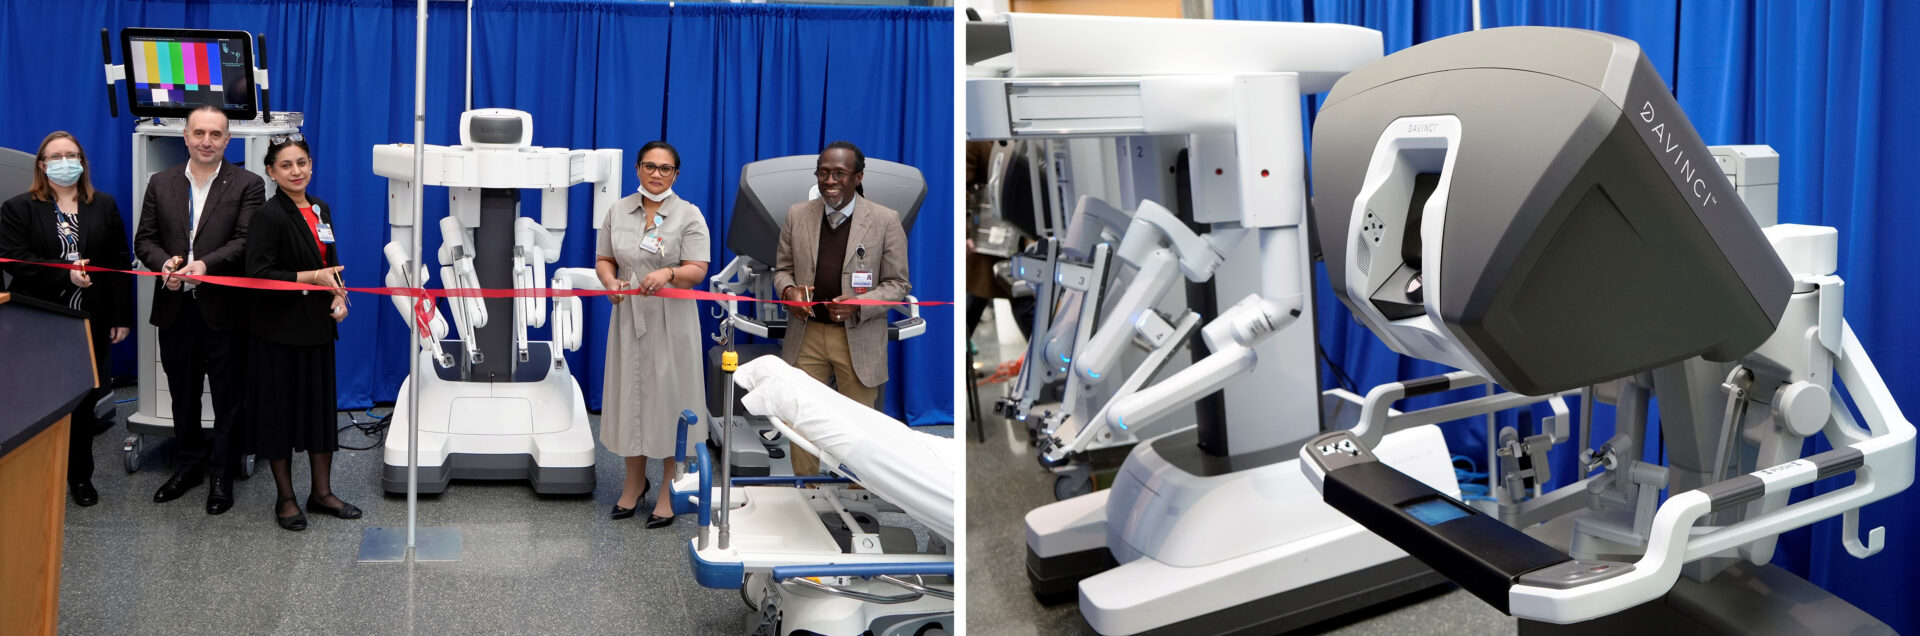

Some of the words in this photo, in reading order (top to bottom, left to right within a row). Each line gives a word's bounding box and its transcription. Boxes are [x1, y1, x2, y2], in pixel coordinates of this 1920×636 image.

[1136, 145, 1144, 158] 2
[1036, 269, 1042, 278] 2
[1078, 276, 1085, 286] 3
